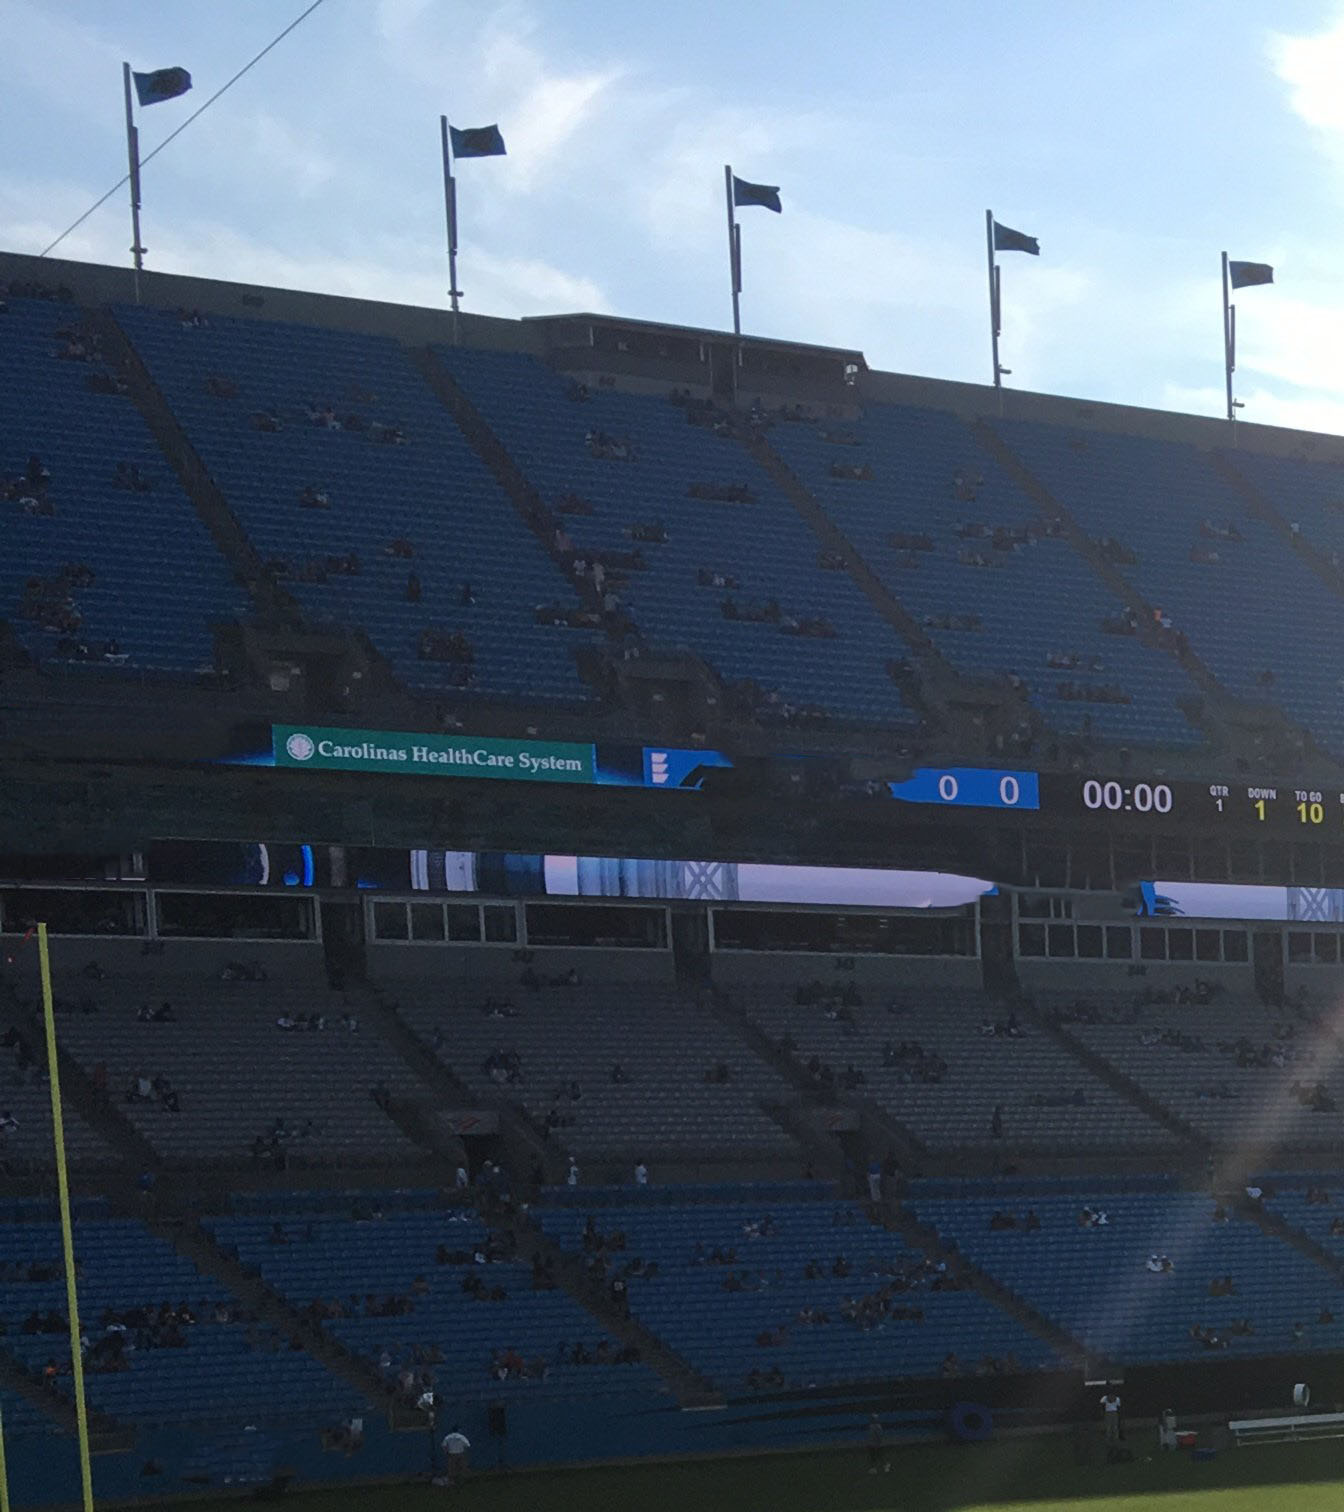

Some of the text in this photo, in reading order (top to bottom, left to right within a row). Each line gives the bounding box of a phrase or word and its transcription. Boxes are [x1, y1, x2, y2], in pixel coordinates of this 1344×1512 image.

[317, 740, 583, 773] Carolinas HealthCare System
[938, 775, 958, 801] 0
[1000, 776, 1020, 805] 0
[1083, 780, 1172, 813] 00:00
[1209, 785, 1229, 797] QTR
[1247, 787, 1277, 800] DOWN
[1294, 790, 1323, 802] TO GO
[1215, 799, 1223, 812] 1
[1254, 800, 1265, 821] 1
[1296, 802, 1324, 823] 10
